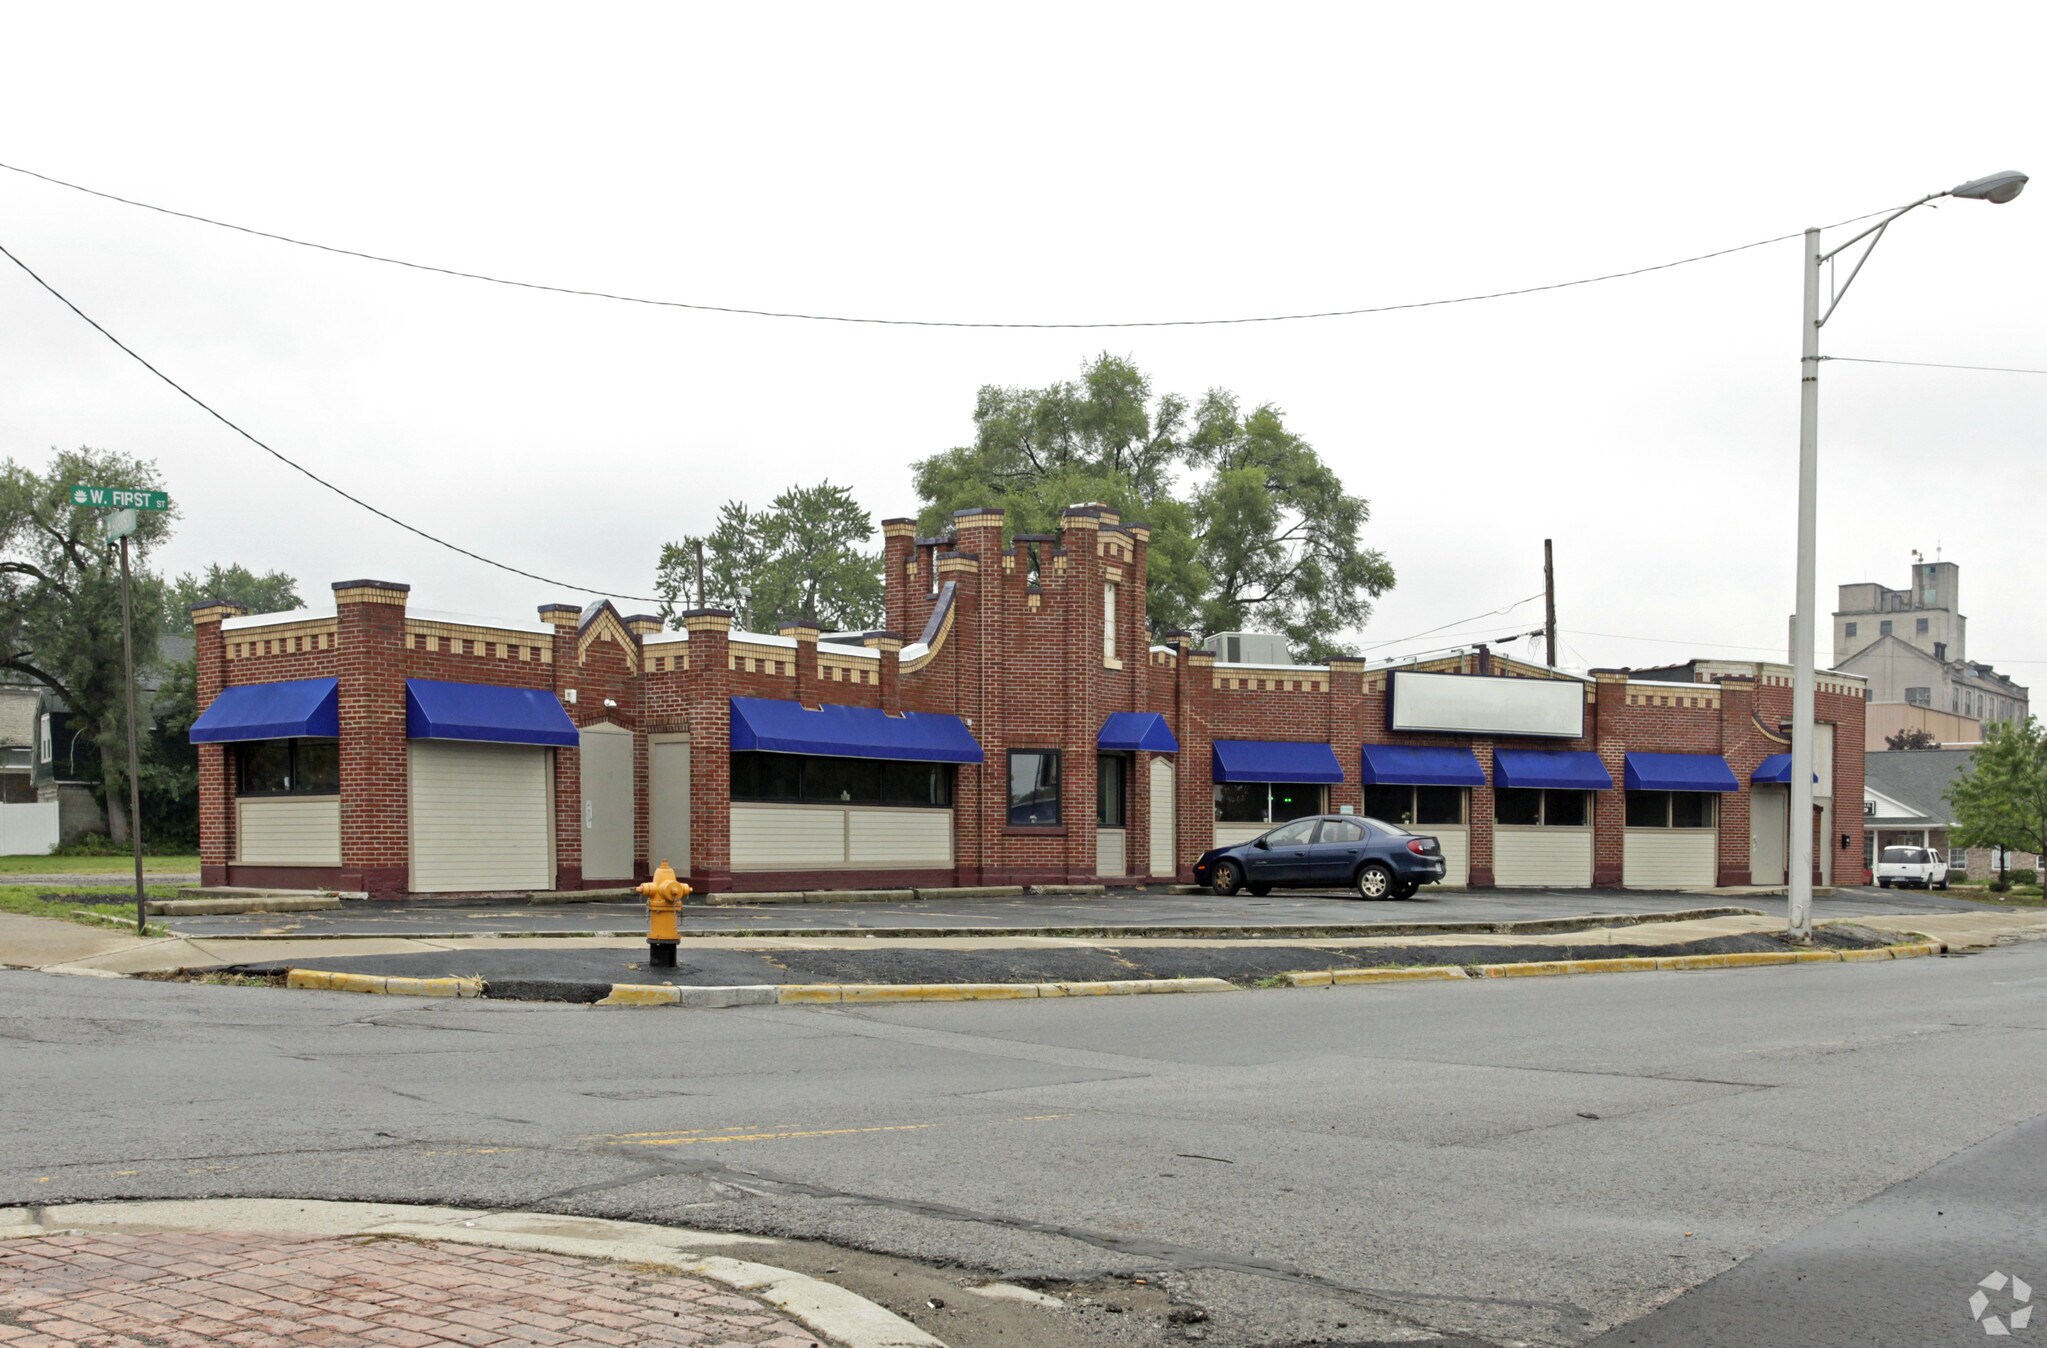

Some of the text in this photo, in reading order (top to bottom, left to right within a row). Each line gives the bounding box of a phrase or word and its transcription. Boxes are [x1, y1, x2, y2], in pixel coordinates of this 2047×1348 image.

[90, 489, 166, 508] W. FIRST ST
